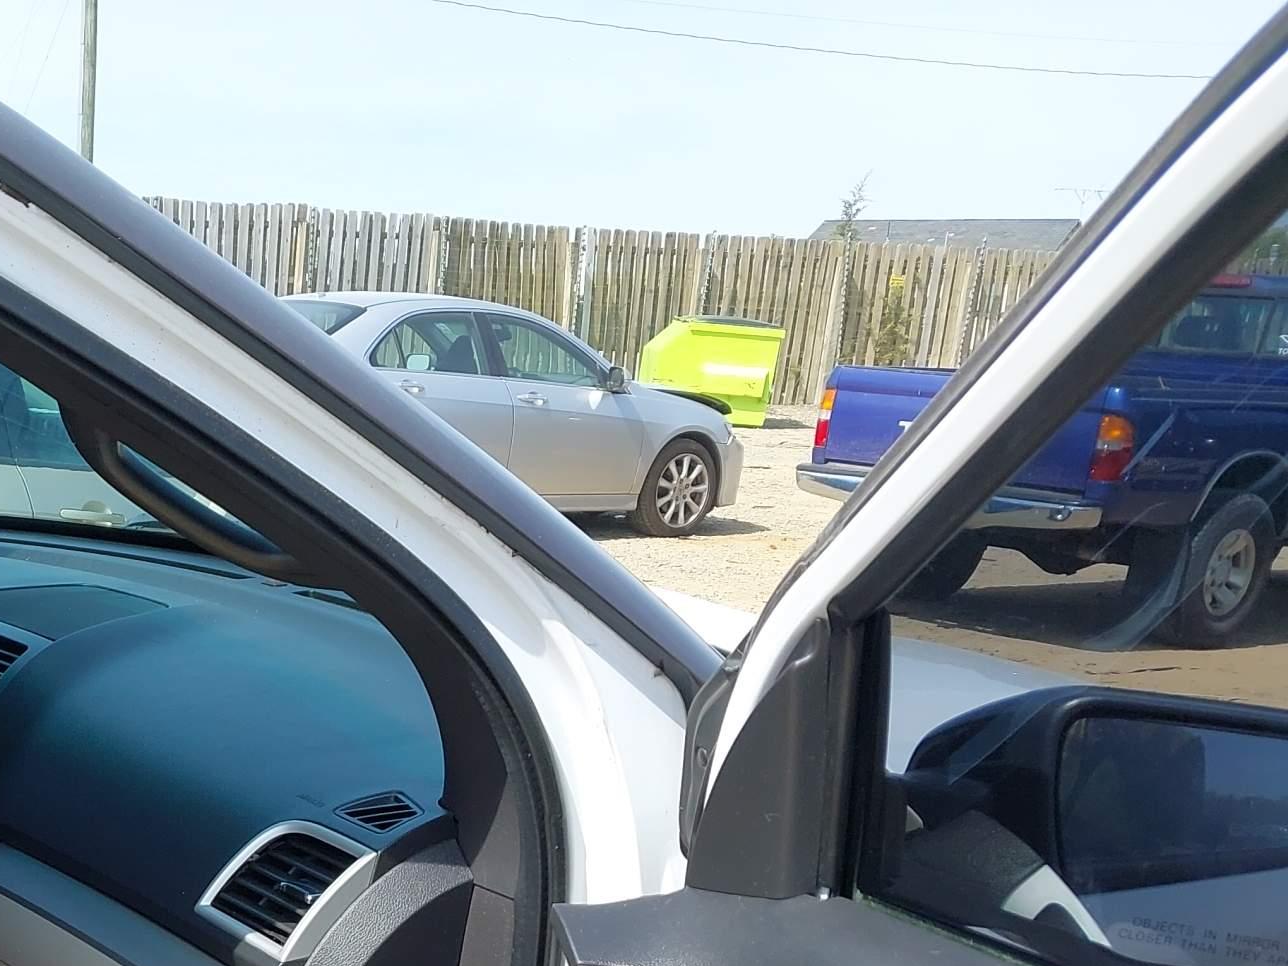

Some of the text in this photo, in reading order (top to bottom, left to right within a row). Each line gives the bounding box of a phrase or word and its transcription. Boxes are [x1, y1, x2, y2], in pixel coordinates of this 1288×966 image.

[1118, 927, 1263, 961] CLOSER THAN THEY
[1132, 917, 1280, 951] OBJECTS IN MIRROR
